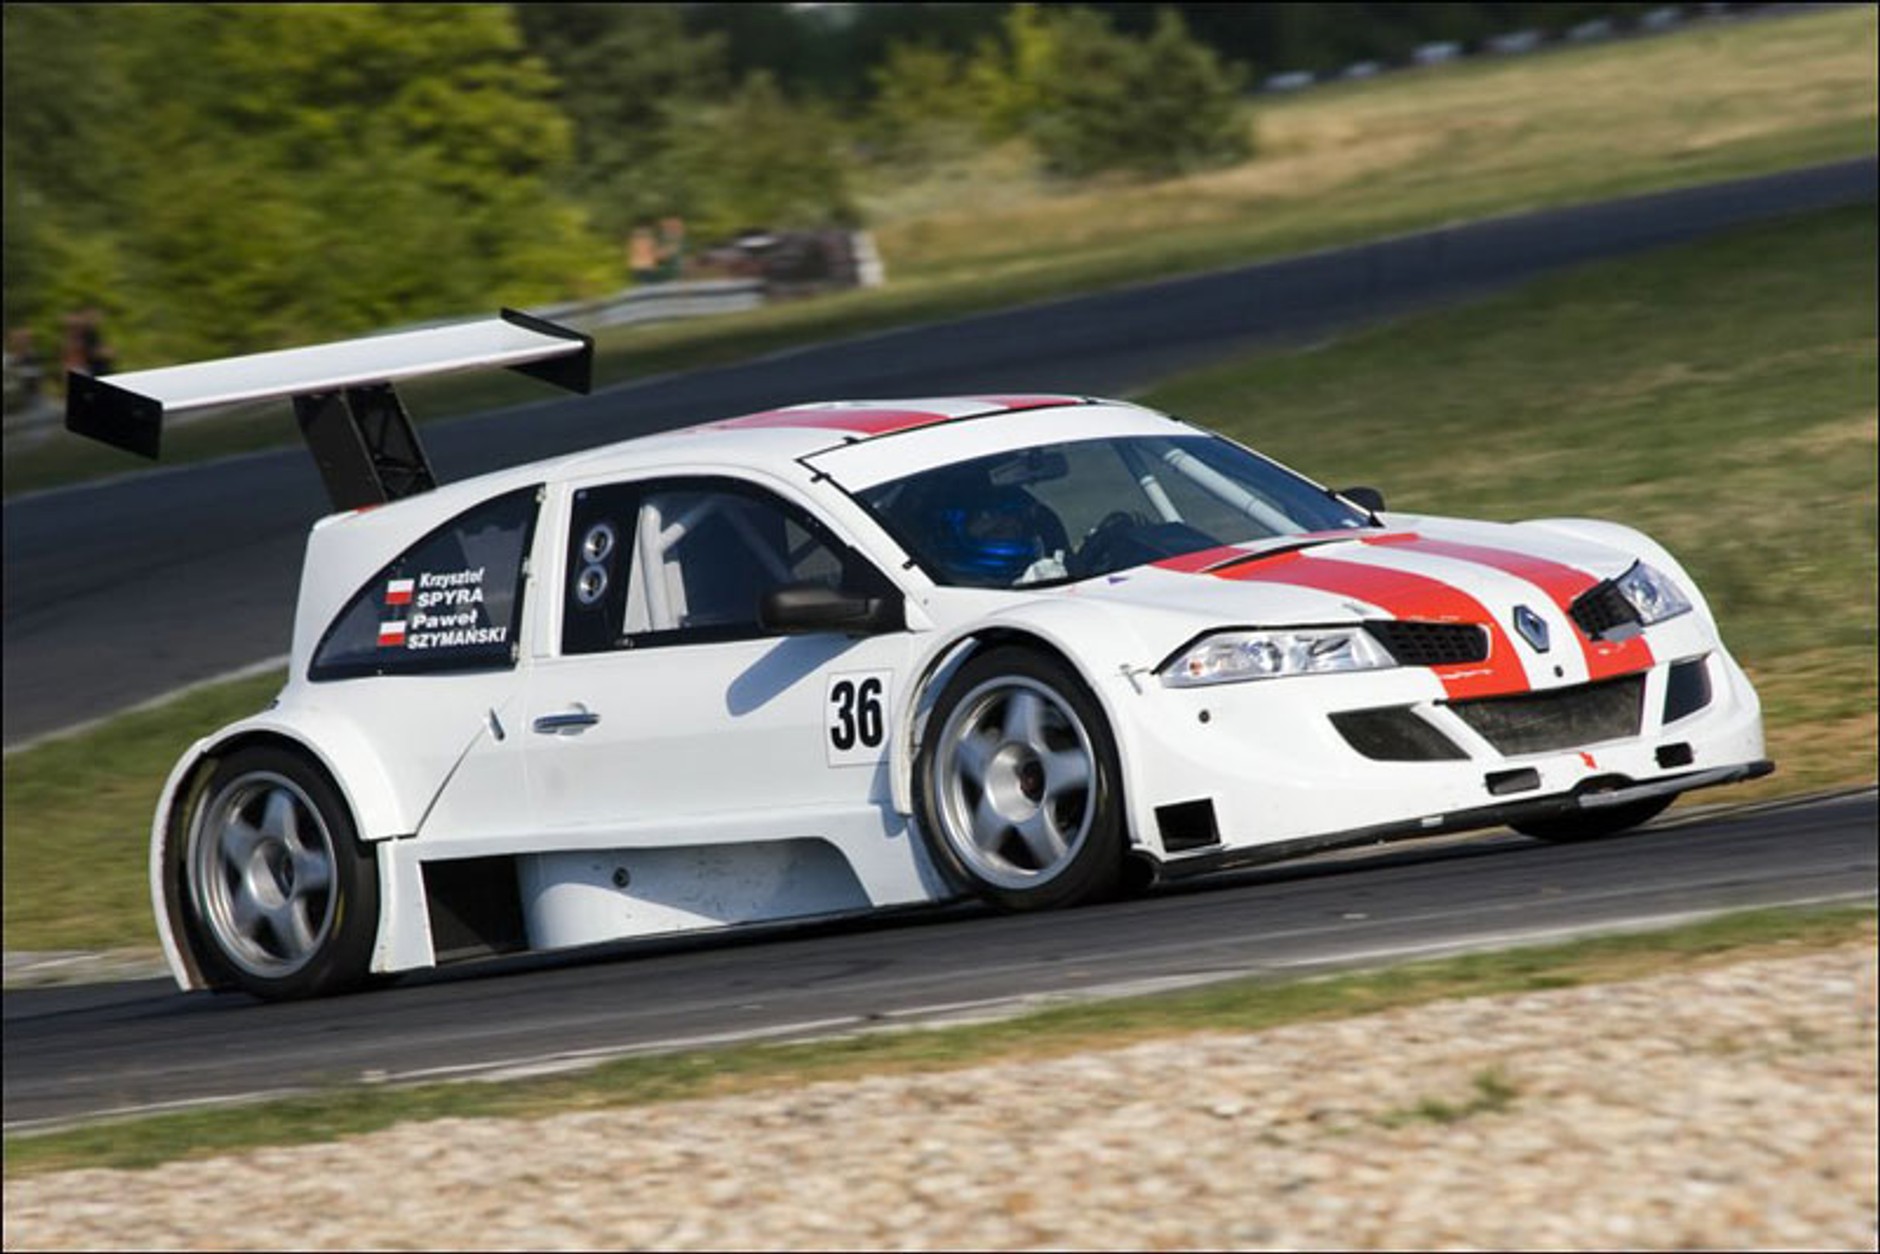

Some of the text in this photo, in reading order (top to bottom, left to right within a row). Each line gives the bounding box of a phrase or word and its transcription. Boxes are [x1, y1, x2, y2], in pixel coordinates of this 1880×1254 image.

[419, 566, 485, 588] Krzysztof
[417, 587, 483, 607] SPYRA
[411, 608, 478, 629] Paweł
[407, 626, 507, 649] SZYMAŃSKI
[830, 677, 883, 750] 36
